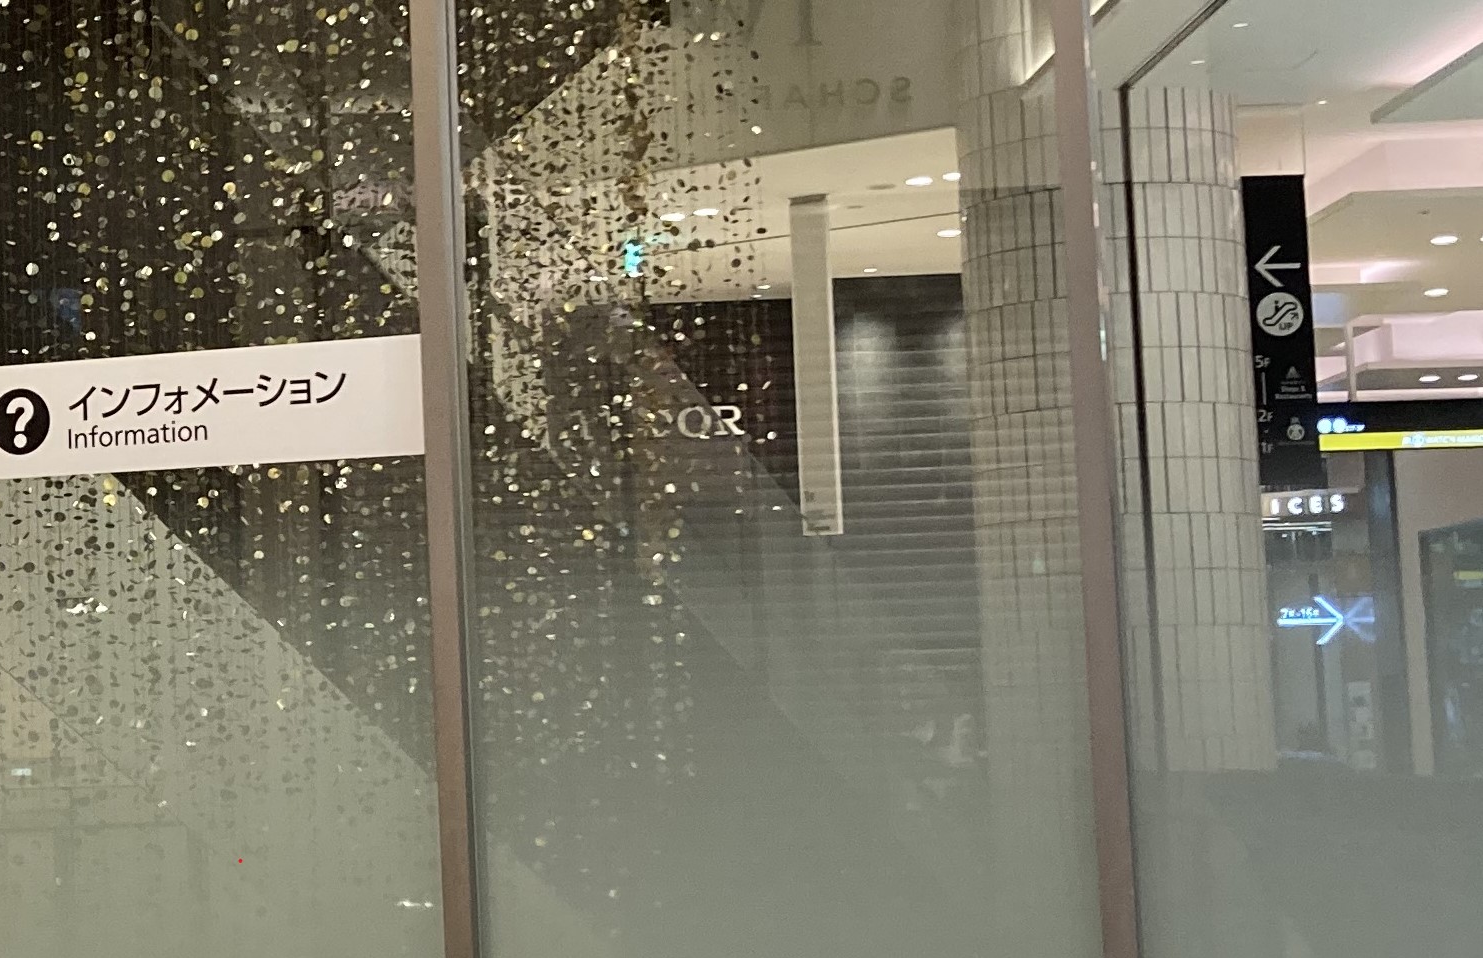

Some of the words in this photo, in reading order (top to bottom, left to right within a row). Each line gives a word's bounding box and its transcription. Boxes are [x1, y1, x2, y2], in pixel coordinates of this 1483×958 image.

[1254, 355, 1271, 369] 5F
[68, 370, 347, 422] インフォメーション
[1257, 411, 1274, 424] 2F
[67, 420, 209, 450] Information
